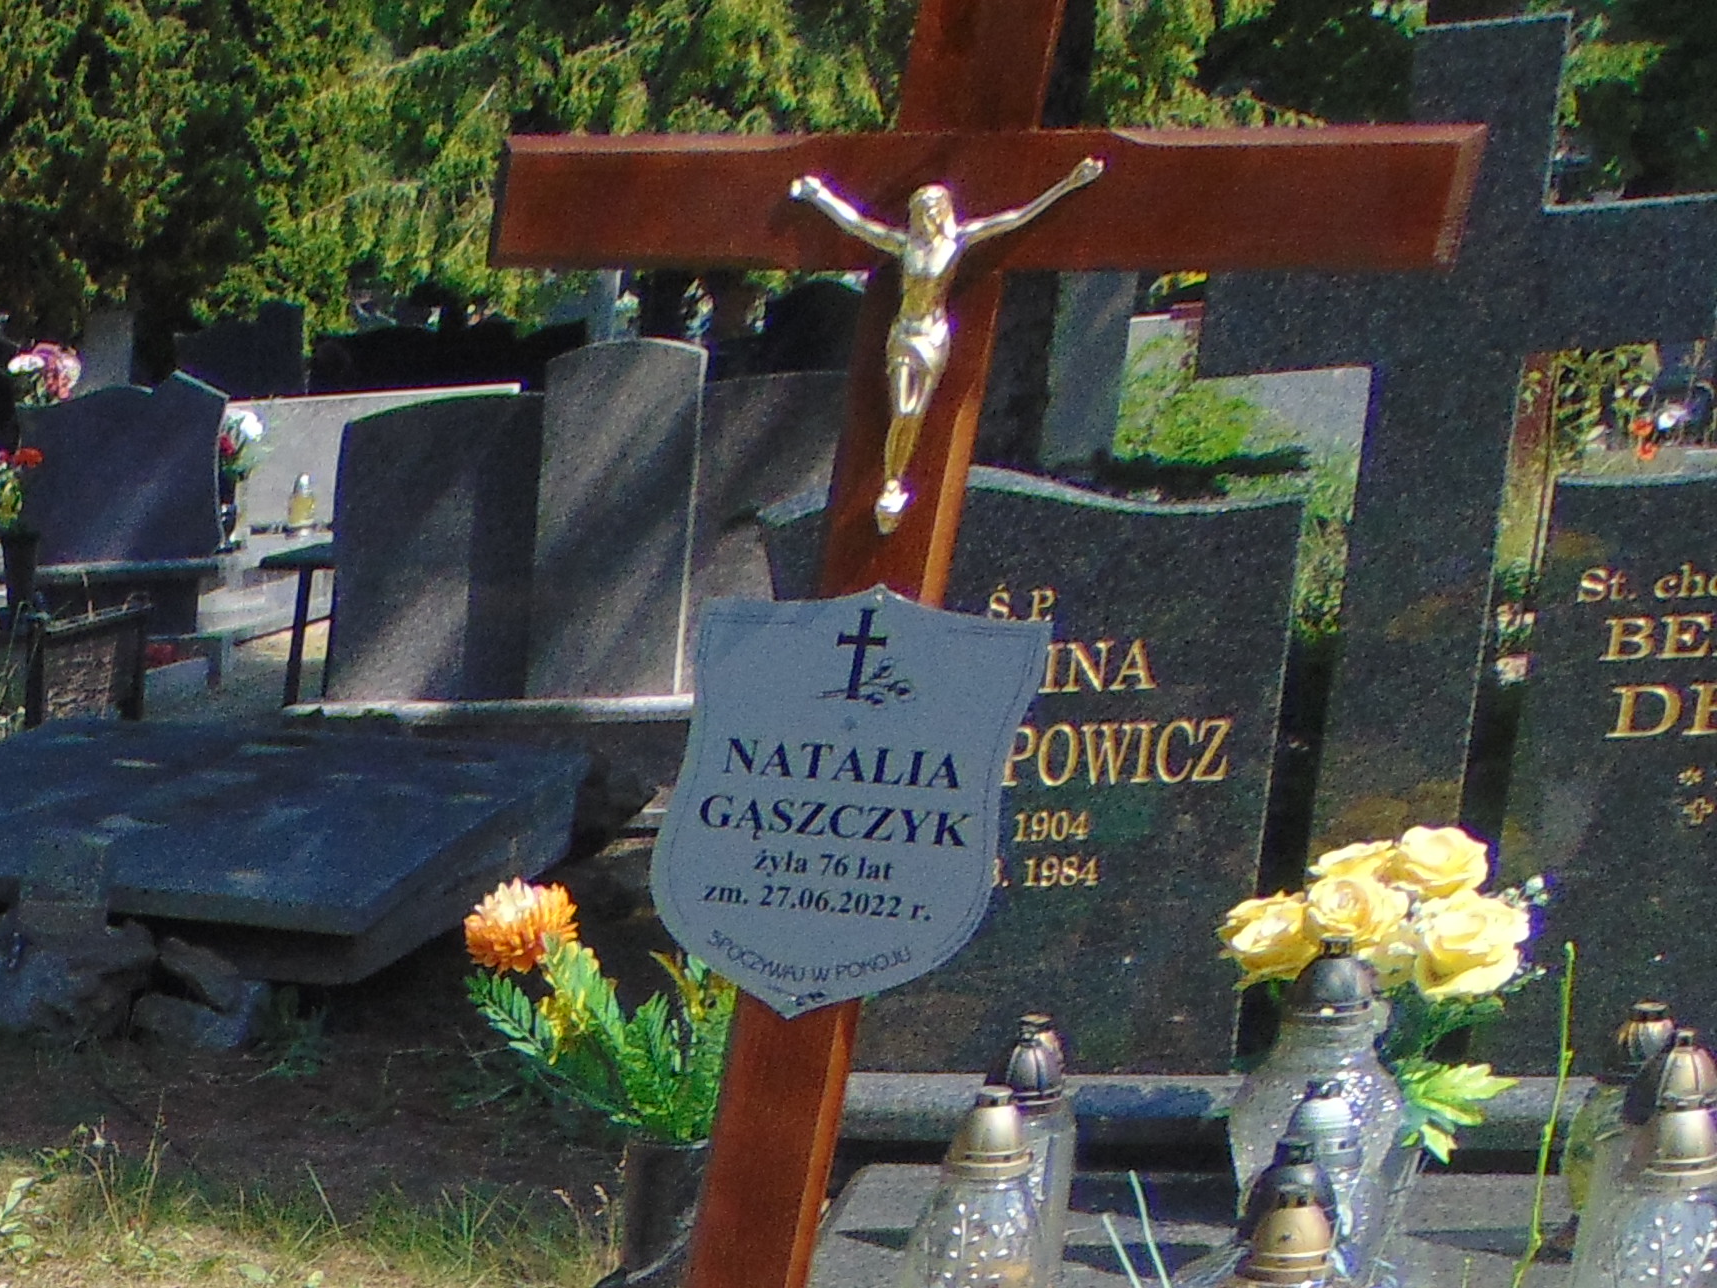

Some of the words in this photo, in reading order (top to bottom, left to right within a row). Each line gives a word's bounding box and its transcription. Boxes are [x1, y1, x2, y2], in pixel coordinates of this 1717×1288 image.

[1599, 613, 1717, 662] BE
[1038, 637, 1158, 693] INA
[722, 737, 961, 789] NATALIA
[1000, 715, 1235, 787] POWICZ
[699, 793, 971, 847] GĄSZCZYK
[1013, 809, 1092, 842] 1904
[819, 853, 849, 878] 76
[856, 855, 894, 881] lat
[1022, 854, 1102, 887] 1984
[704, 884, 749, 906] zm.
[758, 884, 903, 919] 27.06.2022
[910, 902, 932, 922] r.
[707, 929, 806, 983] SPOCZYWAJ
[808, 966, 831, 983] W
[834, 944, 912, 980] POKOJU
